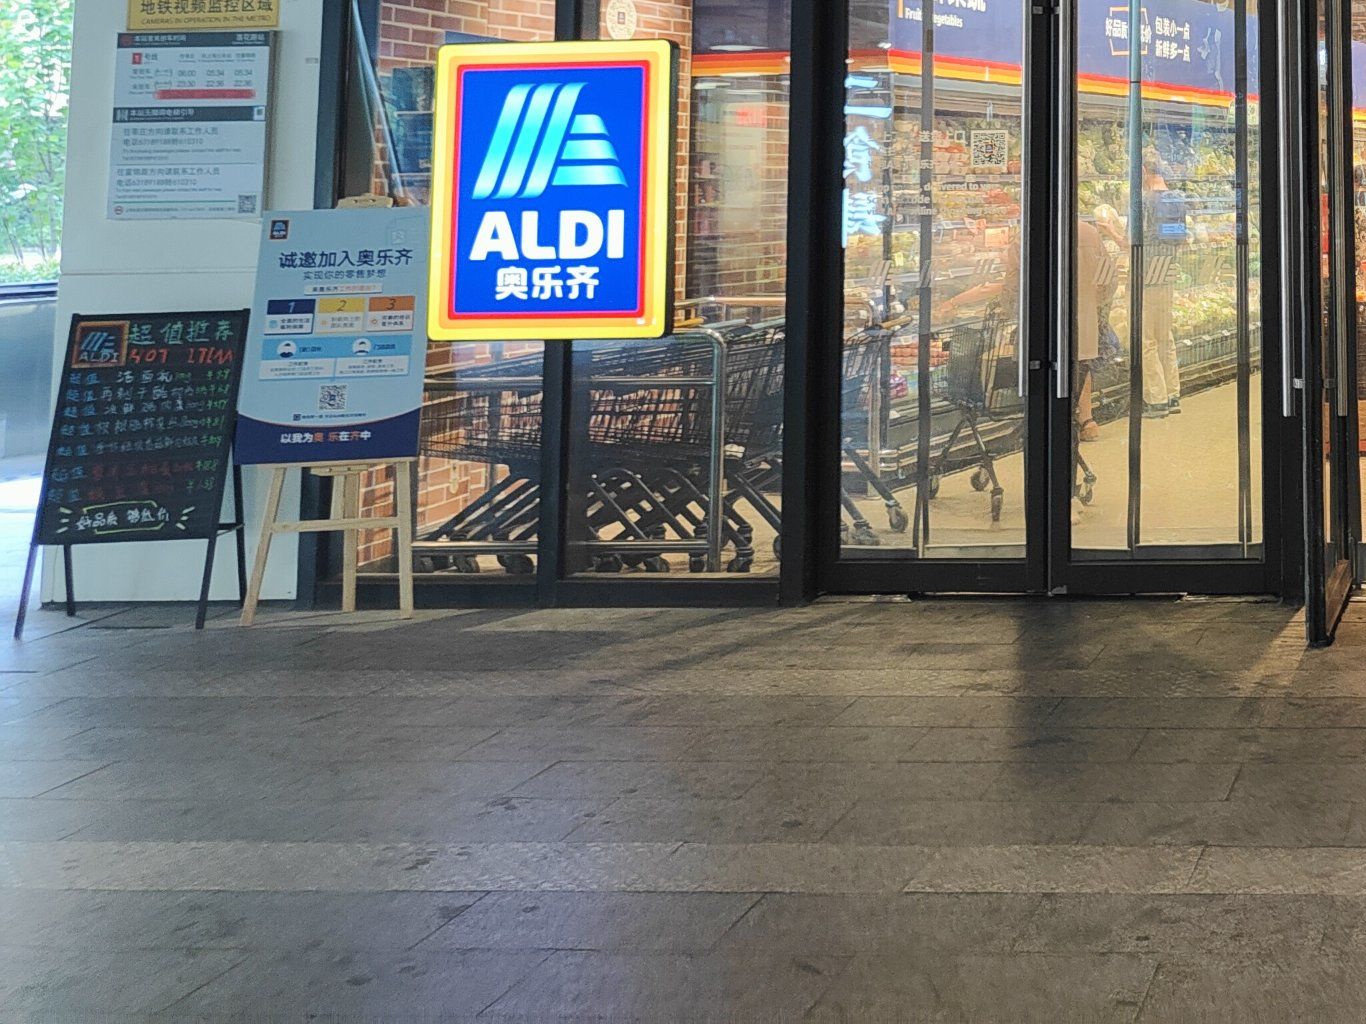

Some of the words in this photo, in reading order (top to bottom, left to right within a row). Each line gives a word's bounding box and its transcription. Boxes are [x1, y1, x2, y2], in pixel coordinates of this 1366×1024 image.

[933, 13, 964, 28] egetables
[1154, 15, 1190, 40] 包装小一点
[1154, 39, 1191, 63] 新鲜多一点
[469, 209, 625, 261] ALDI
[279, 248, 414, 269] 诚邀加入奥乐齐
[303, 269, 387, 281] 实现你的零售梦想
[495, 265, 600, 300] 奥乐齐
[288, 301, 297, 312] 1
[336, 300, 348, 313] 2
[385, 300, 397, 311] 3
[78, 351, 121, 364] ALDI
